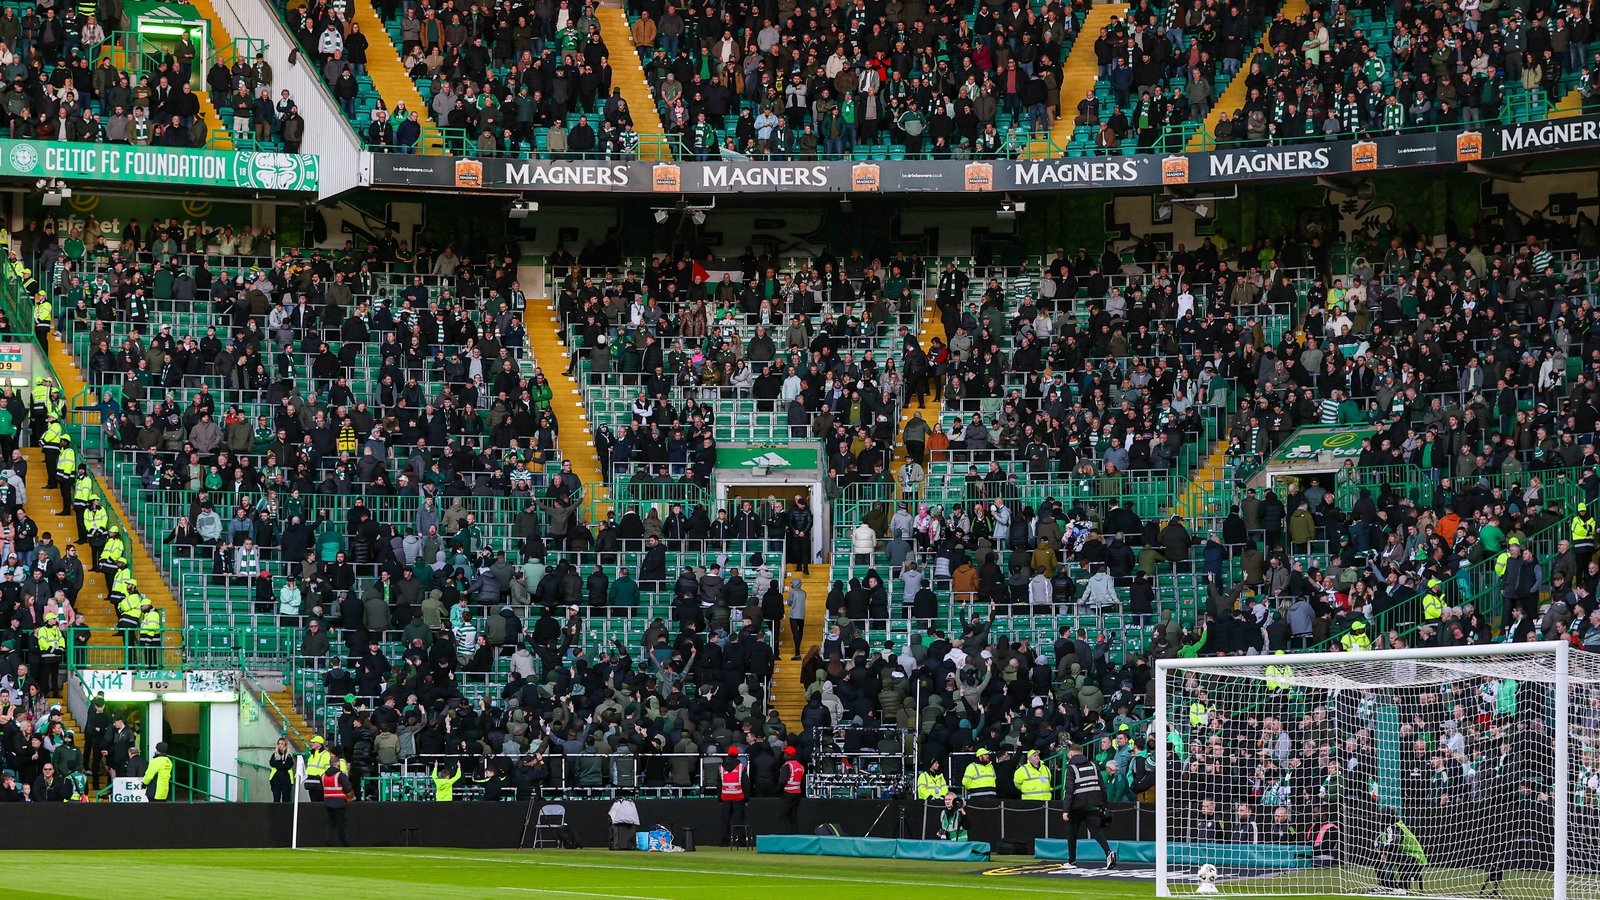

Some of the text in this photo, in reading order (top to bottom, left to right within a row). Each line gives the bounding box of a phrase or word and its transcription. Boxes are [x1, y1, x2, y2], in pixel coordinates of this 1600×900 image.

[46, 148, 226, 179] CELTIC FC FOUNDATION
[239, 167, 247, 176] 18
[1015, 160, 1138, 184] MAGNERS
[1210, 148, 1329, 176] MAGNERS
[505, 163, 629, 185] MAGNERS
[703, 166, 827, 186] MAGNERS
[149, 681, 169, 689] 109
[114, 793, 142, 802] Gate
